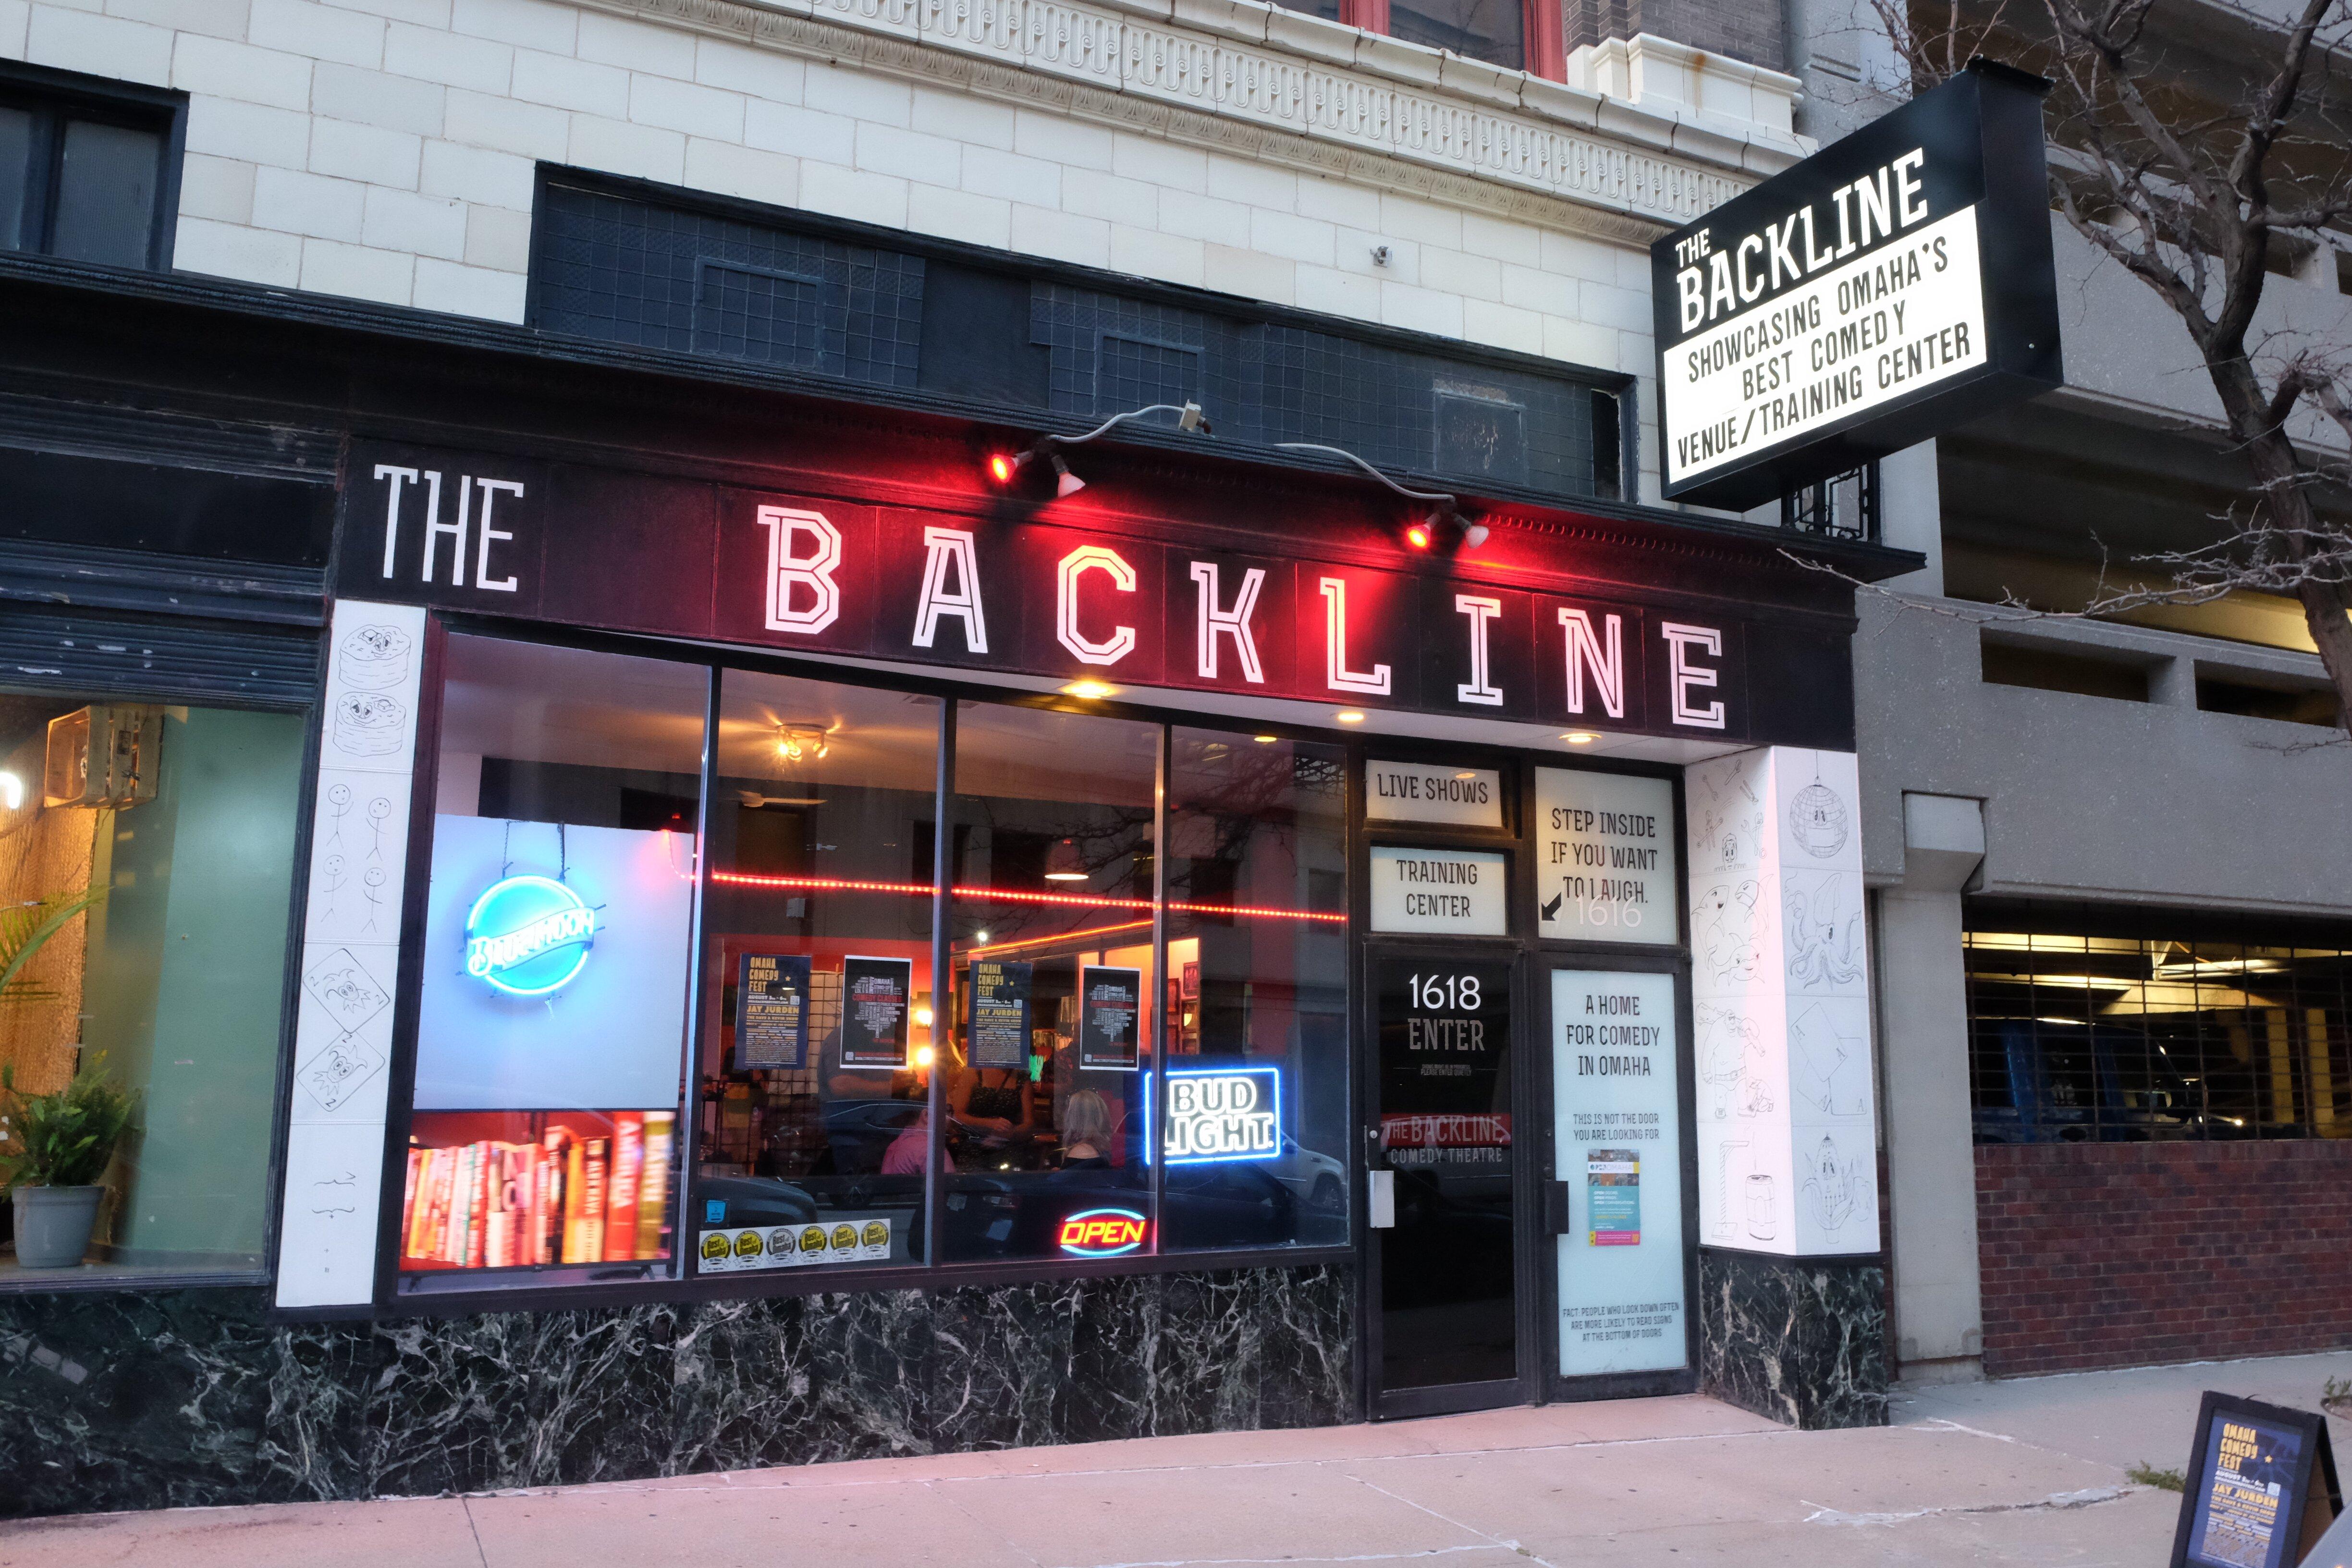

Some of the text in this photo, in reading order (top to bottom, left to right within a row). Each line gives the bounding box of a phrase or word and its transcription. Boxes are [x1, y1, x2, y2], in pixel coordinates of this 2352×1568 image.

[1675, 228, 1710, 268] THE
[1677, 147, 1928, 333] BACKLINE
[1688, 236, 1948, 382] SHOWCASING OMAHA'S
[1743, 300, 1906, 401] BEST COMEDY
[1678, 322, 1971, 468] VENUE/TRAINING CENTER
[374, 464, 1726, 729] THE BACKLINE
[1377, 774, 1489, 804] LIVE SHOWS
[1552, 808, 1656, 838] STEP INSIDE
[1551, 842, 1658, 871] IF YOU WANT
[1396, 860, 1478, 885] TRAINING
[1563, 877, 1649, 904] TO LAUGH.
[1407, 894, 1471, 918] CENTER
[1575, 894, 1642, 929] 1616
[750, 957, 776, 968] OMAHA
[979, 963, 1001, 974] OMAHA
[749, 969, 779, 981] COMEDY
[749, 981, 767, 992] FEST
[978, 975, 1004, 986] COMEDY
[978, 986, 994, 996] FEST
[1409, 973, 1481, 1010] 1618
[1586, 995, 1641, 1016] A HOME
[1408, 1018, 1485, 1051] ENTER
[1566, 1025, 1660, 1046] FOR COMEDY
[1578, 1055, 1651, 1076] IN OMAHA
[1169, 1077, 1257, 1117] BUD
[1385, 1116, 1502, 1143] THE BACKLINE
[1573, 1114, 1659, 1125] THIS IS NOT THE DOOR
[1573, 1129, 1659, 1140] YOU ARE LOOKING FOR
[1390, 1147, 1503, 1164] COMEDY THEATRE
[1060, 1221, 1146, 1244] OPEN
[1563, 1302, 1679, 1318] FACT: PEOPLE WHO LOOK DOWN OFTEN
[1571, 1315, 1673, 1330] ARE MORE LIKELY TO READ SIGNS
[1583, 1328, 1662, 1342] AT THE BOTTOM OF DOORS
[2223, 1423, 2256, 1443] OMAHA
[2220, 1438, 2258, 1459] COMEDY
[2218, 1452, 2242, 1470] FEST
[2212, 1483, 2279, 1508] JAY JURDEN
